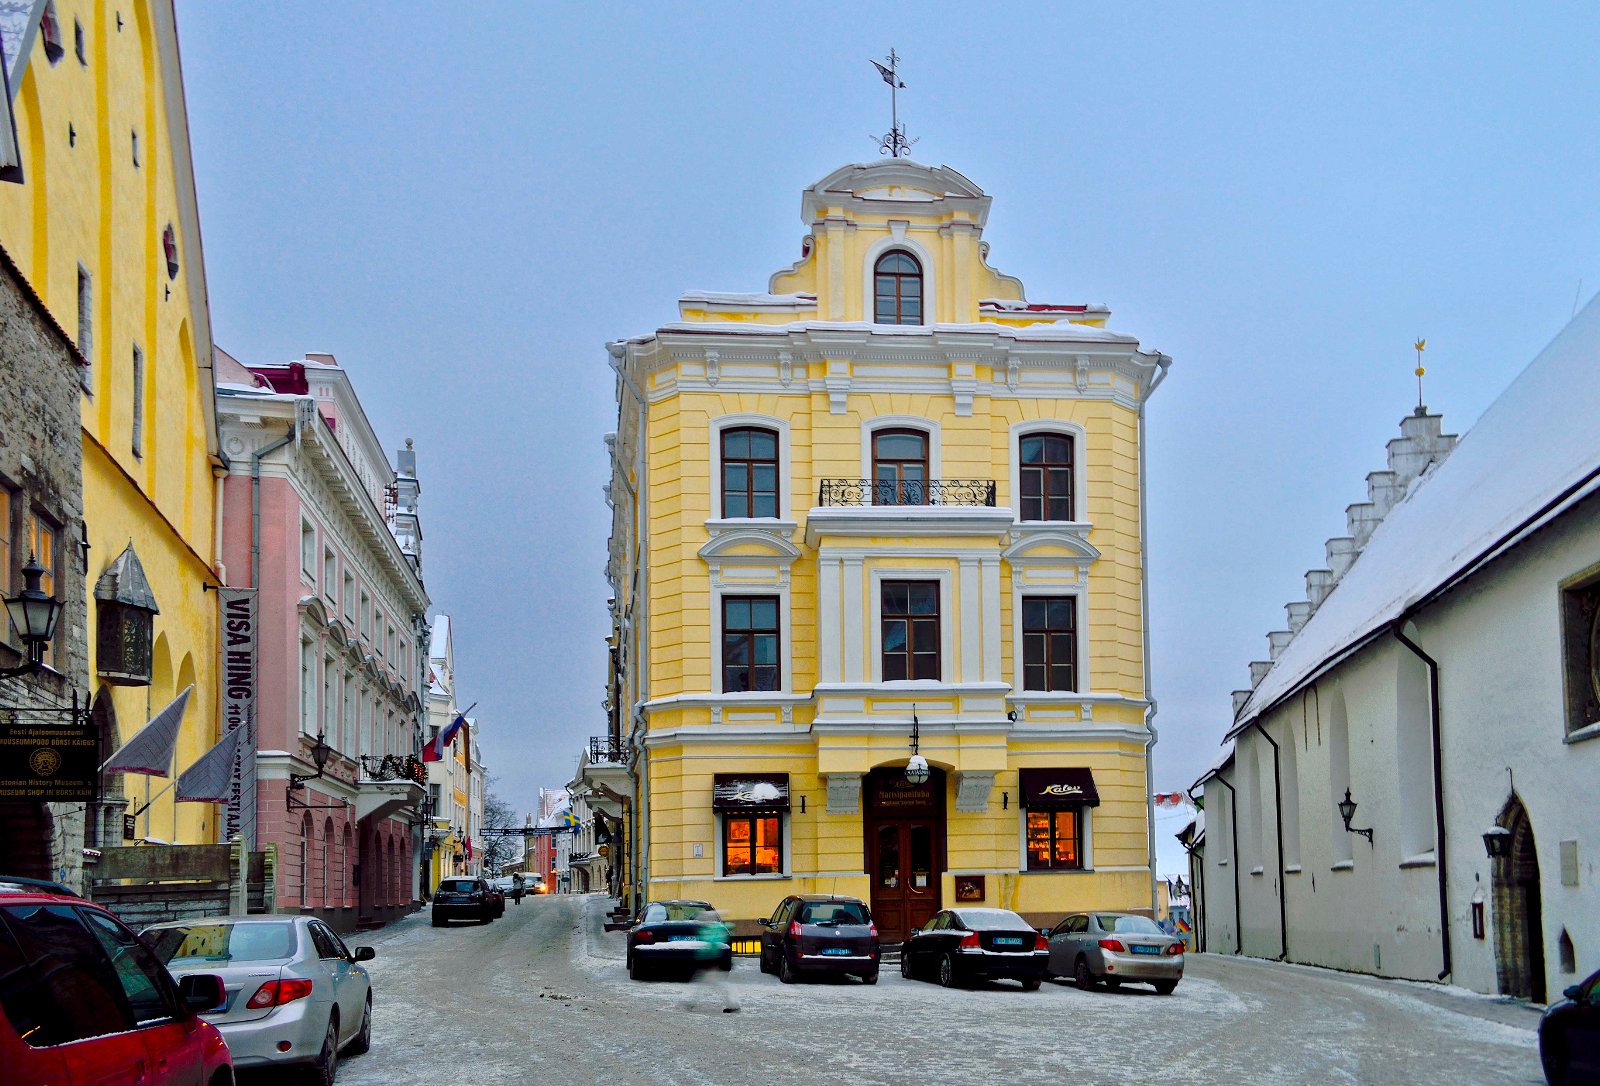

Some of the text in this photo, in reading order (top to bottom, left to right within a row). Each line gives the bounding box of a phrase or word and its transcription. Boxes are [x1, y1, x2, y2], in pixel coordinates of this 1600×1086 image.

[226, 598, 252, 700] VISA HING
[28, 779, 53, 787] History
[1038, 784, 1083, 795] Kalev
